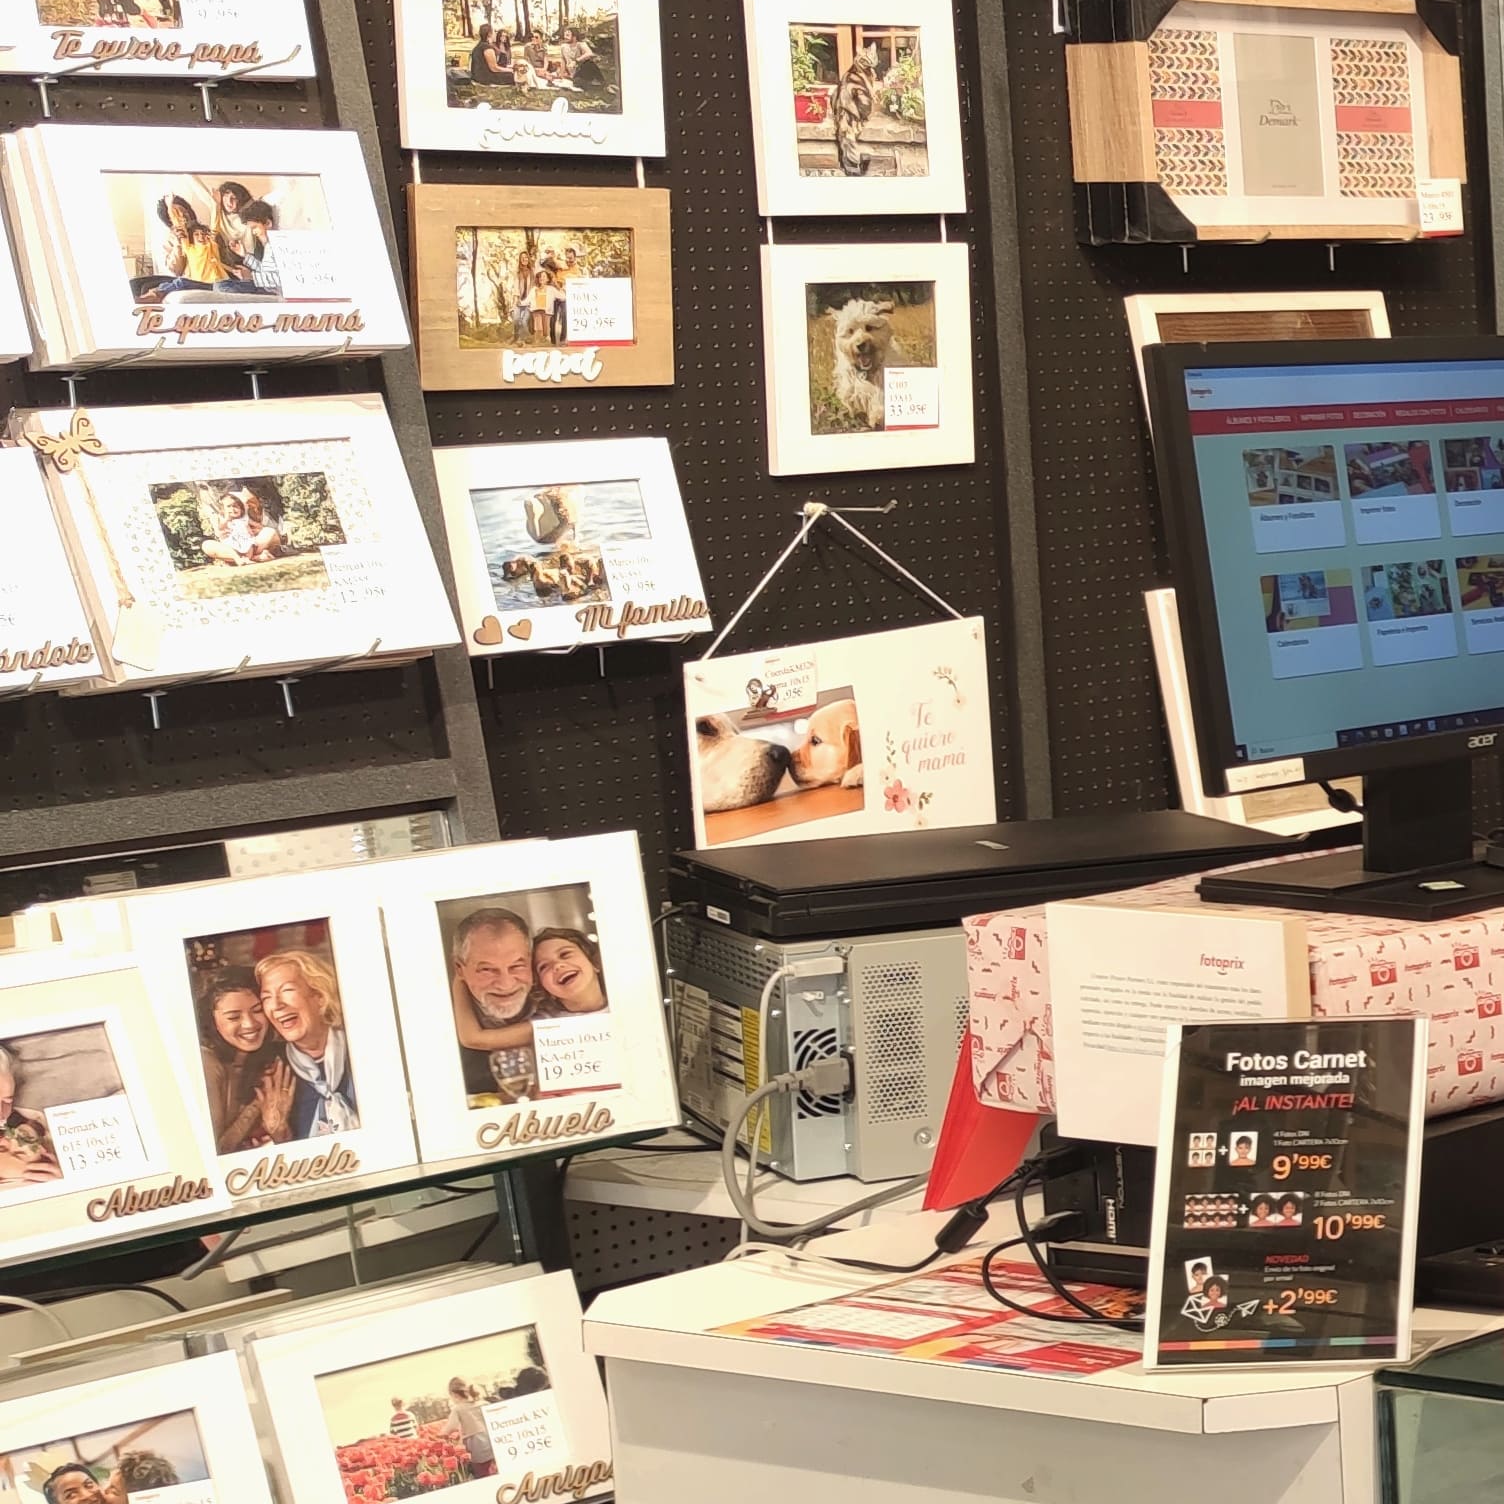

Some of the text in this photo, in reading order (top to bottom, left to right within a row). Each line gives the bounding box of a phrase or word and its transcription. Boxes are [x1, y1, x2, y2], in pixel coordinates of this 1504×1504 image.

[52, 30, 262, 68] Te quiero papá
[133, 307, 364, 337] Te quiero mamá
[1468, 732, 1496, 748] acer
[1226, 1050, 1367, 1071] Fotos Carnet
[1240, 1072, 1350, 1088] imagen mejorada
[1265, 1093, 1355, 1110] INSTANTE!
[477, 1107, 613, 1149] Abuelo
[227, 1146, 359, 1196] Abuela
[88, 1176, 212, 1221] Abuelos
[1265, 1254, 1309, 1264] NOVEDAD
